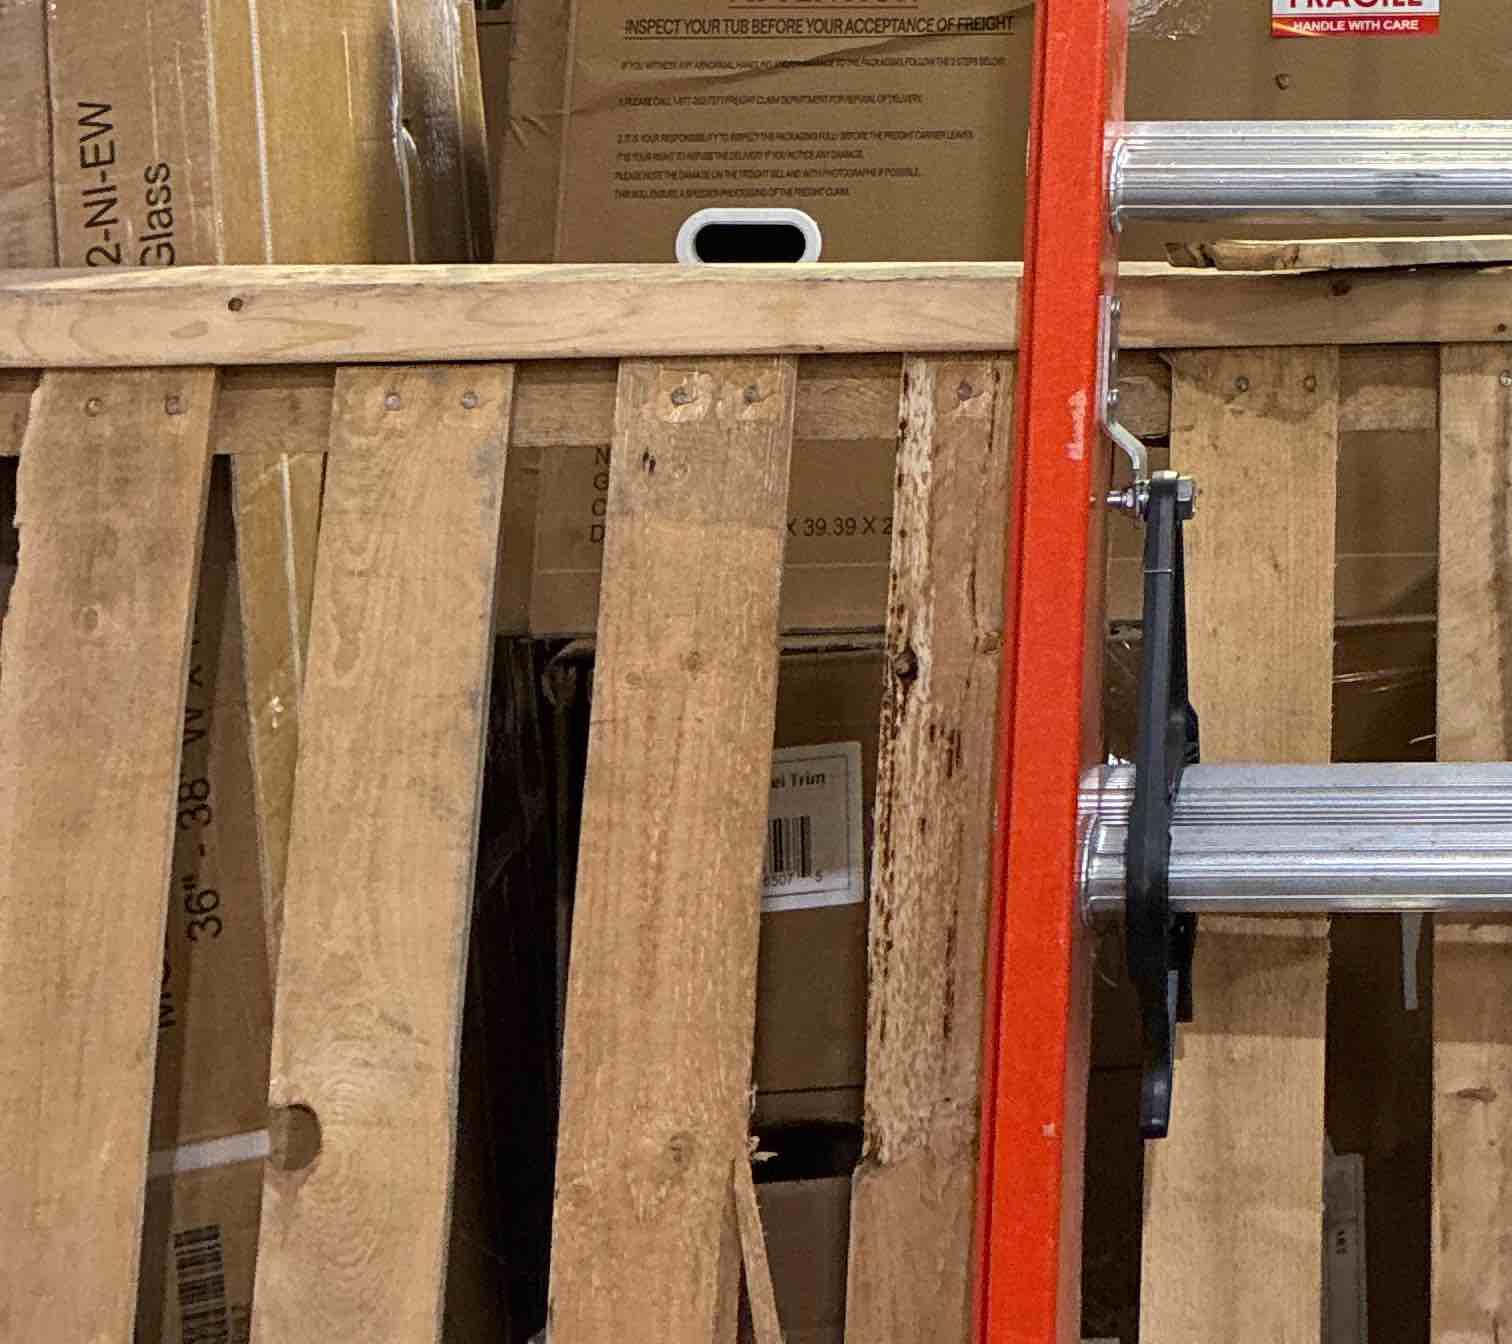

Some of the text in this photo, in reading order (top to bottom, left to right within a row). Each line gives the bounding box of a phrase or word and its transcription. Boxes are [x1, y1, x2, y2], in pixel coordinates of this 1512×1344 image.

[624, 15, 1015, 35] INSPECT YOUR TUB BEFORE YOUR ACCEPTANCE OF FREIGHT
[1293, 19, 1419, 33] HANDLE WITH CARE
[138, 162, 176, 266] Glass
[803, 516, 857, 537] 39.39
[863, 514, 875, 535] X
[791, 771, 827, 787] Trim
[182, 875, 223, 942] 36"
